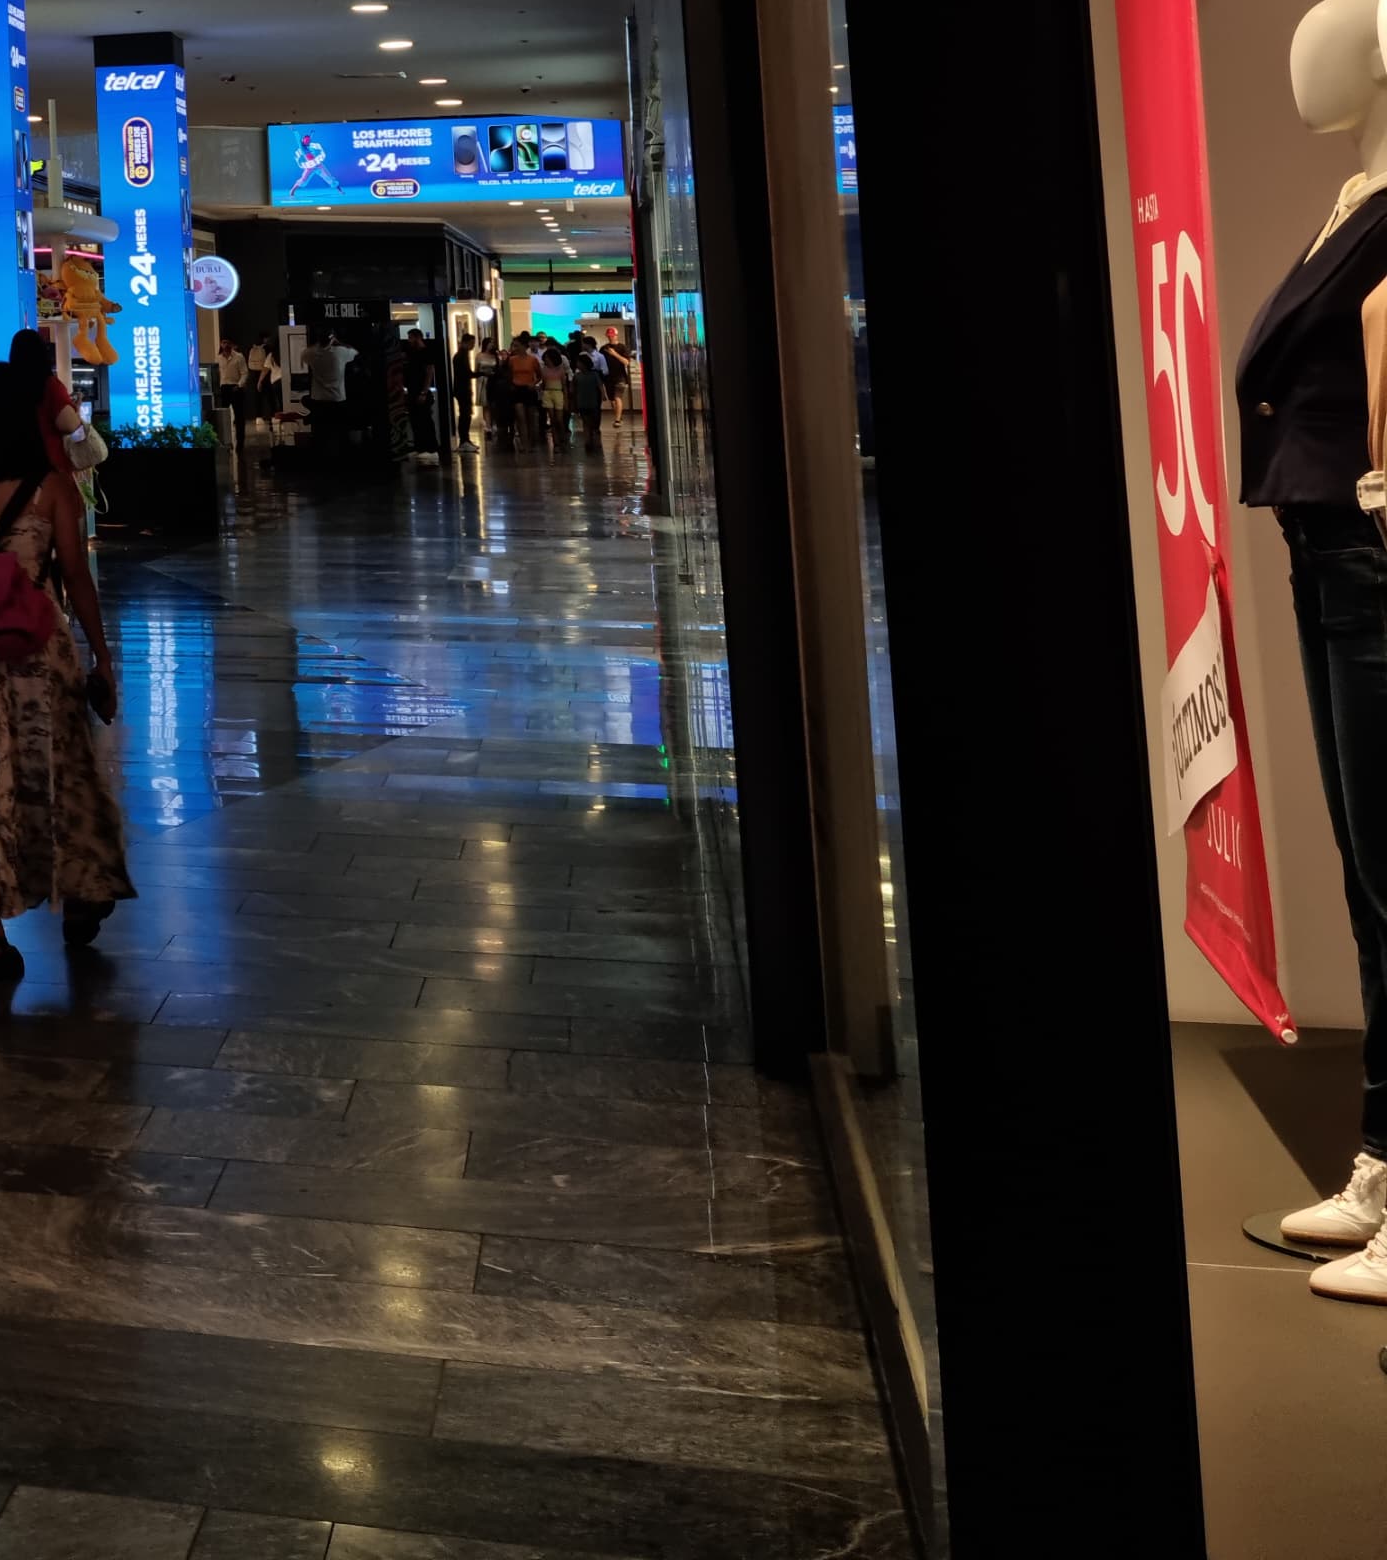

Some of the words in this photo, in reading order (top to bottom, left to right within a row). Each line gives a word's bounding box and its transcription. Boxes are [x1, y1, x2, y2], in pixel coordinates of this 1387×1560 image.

[104, 70, 165, 91] telcel
[352, 130, 376, 140] LOS
[377, 127, 433, 138] MEJORES
[352, 137, 433, 149] SMARTPHONES
[366, 152, 397, 172] 24
[573, 182, 616, 196] telcel
[1137, 193, 1159, 225] HASTA
[134, 208, 148, 252] MESES
[129, 252, 158, 296] 24
[133, 326, 149, 401] MEJORES
[147, 326, 164, 428] MARTPHONES
